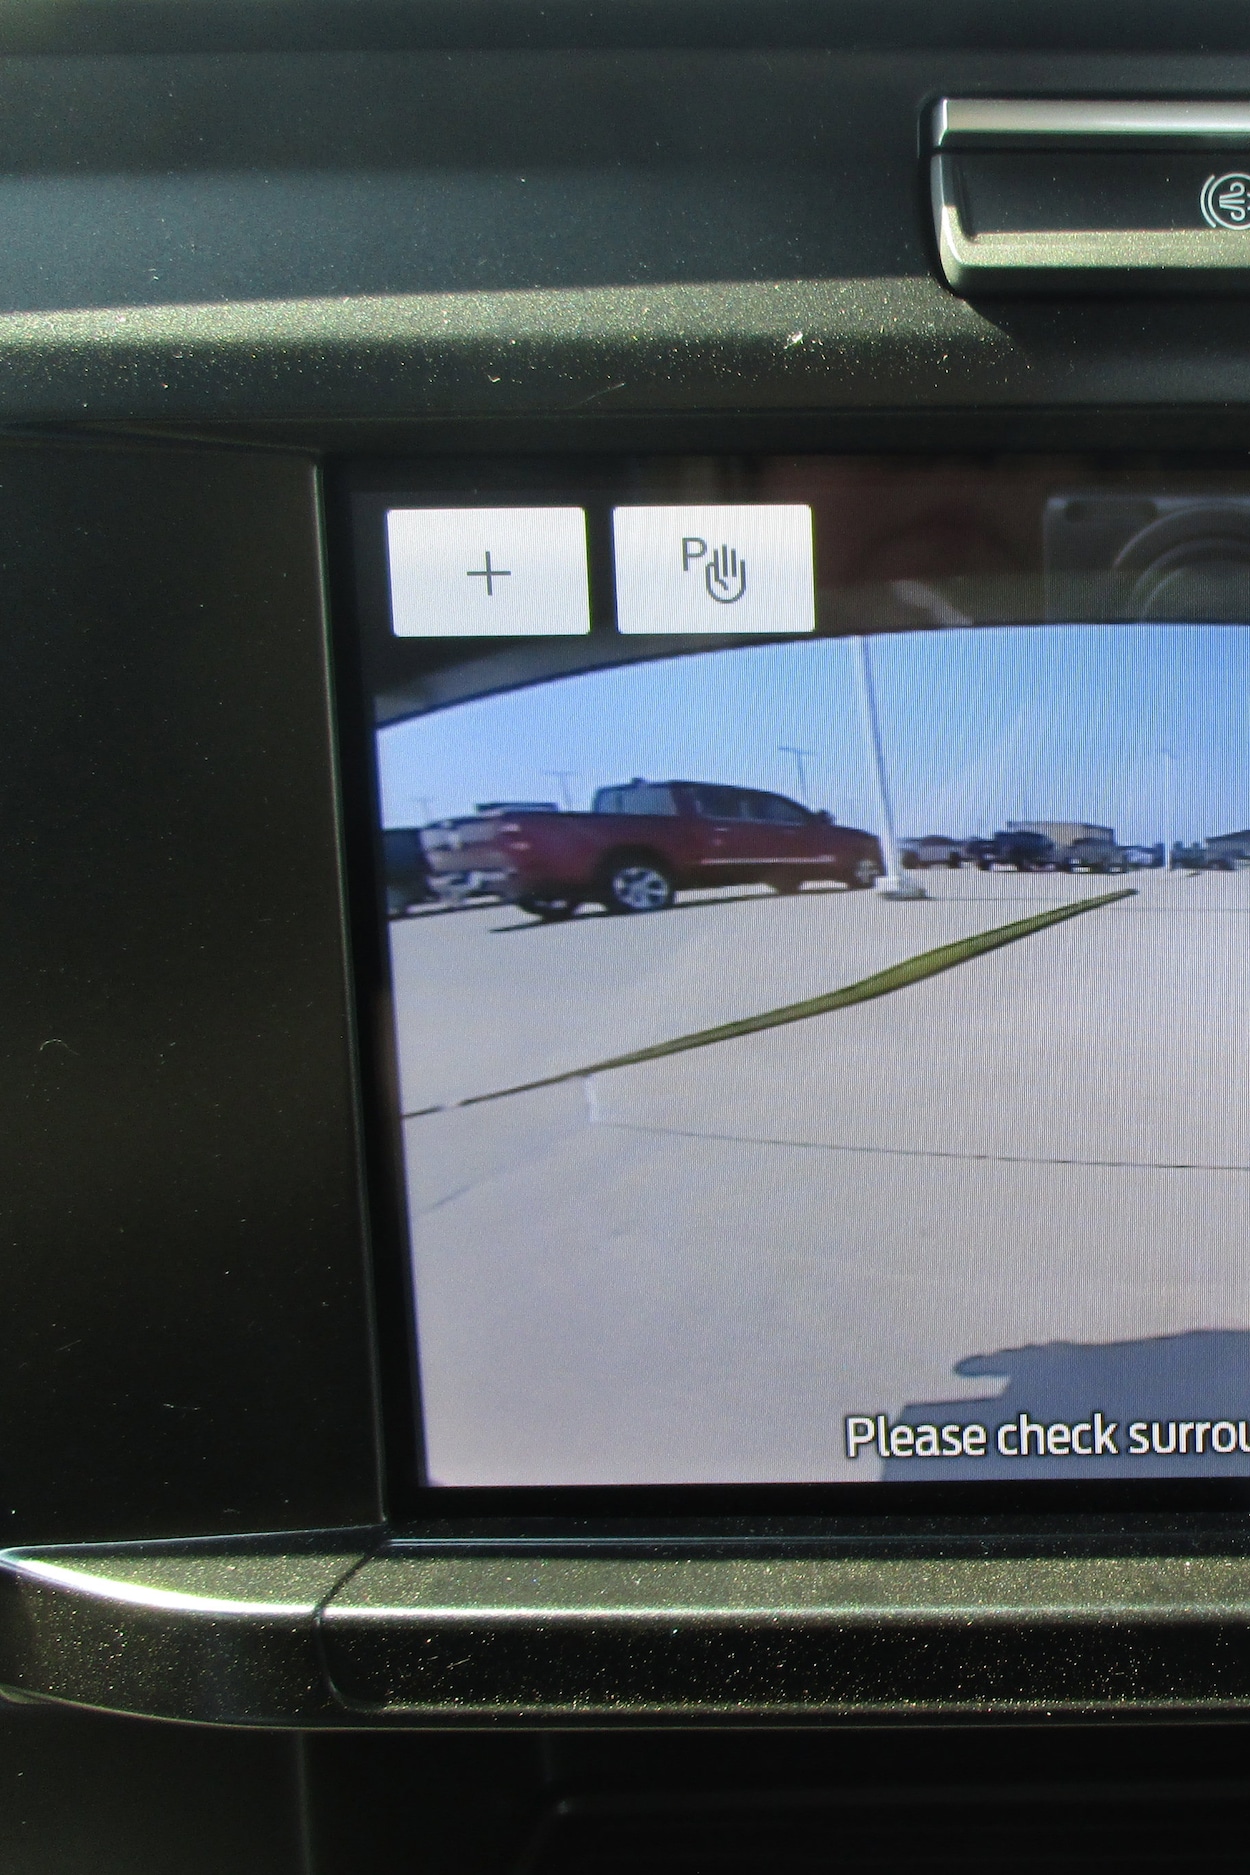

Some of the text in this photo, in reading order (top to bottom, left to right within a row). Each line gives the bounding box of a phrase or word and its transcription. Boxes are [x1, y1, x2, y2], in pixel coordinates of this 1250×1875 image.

[682, 536, 707, 571] P
[846, 1414, 987, 1458] Please
[997, 1413, 1118, 1455] check
